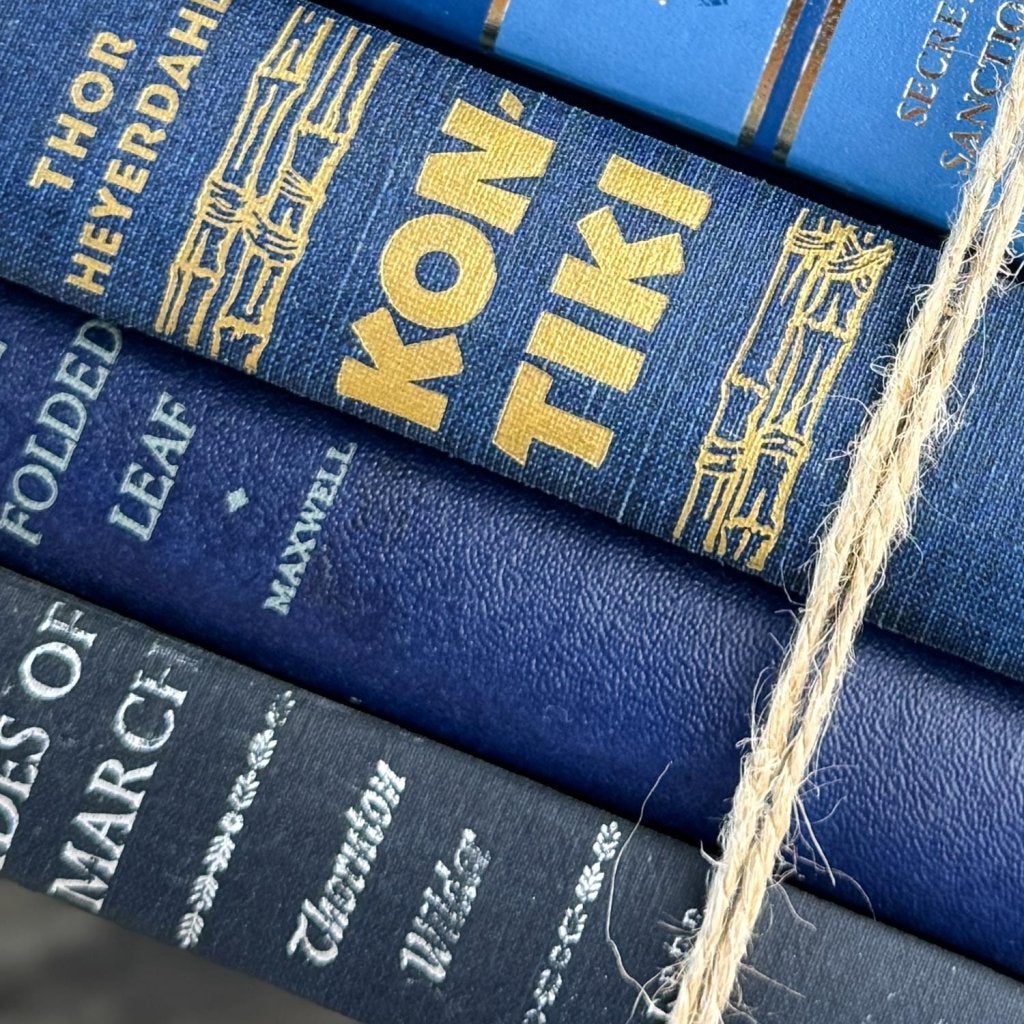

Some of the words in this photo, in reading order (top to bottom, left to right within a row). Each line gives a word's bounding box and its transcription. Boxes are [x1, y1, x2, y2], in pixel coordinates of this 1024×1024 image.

[28, 30, 137, 192] THOR
[491, 154, 713, 469] TIKI
[0, 319, 122, 545] FOLDED
[108, 389, 197, 543] LEAF
[262, 440, 356, 616] MAXWELL
[18, 601, 97, 700] OF
[286, 759, 406, 965] Thornton
